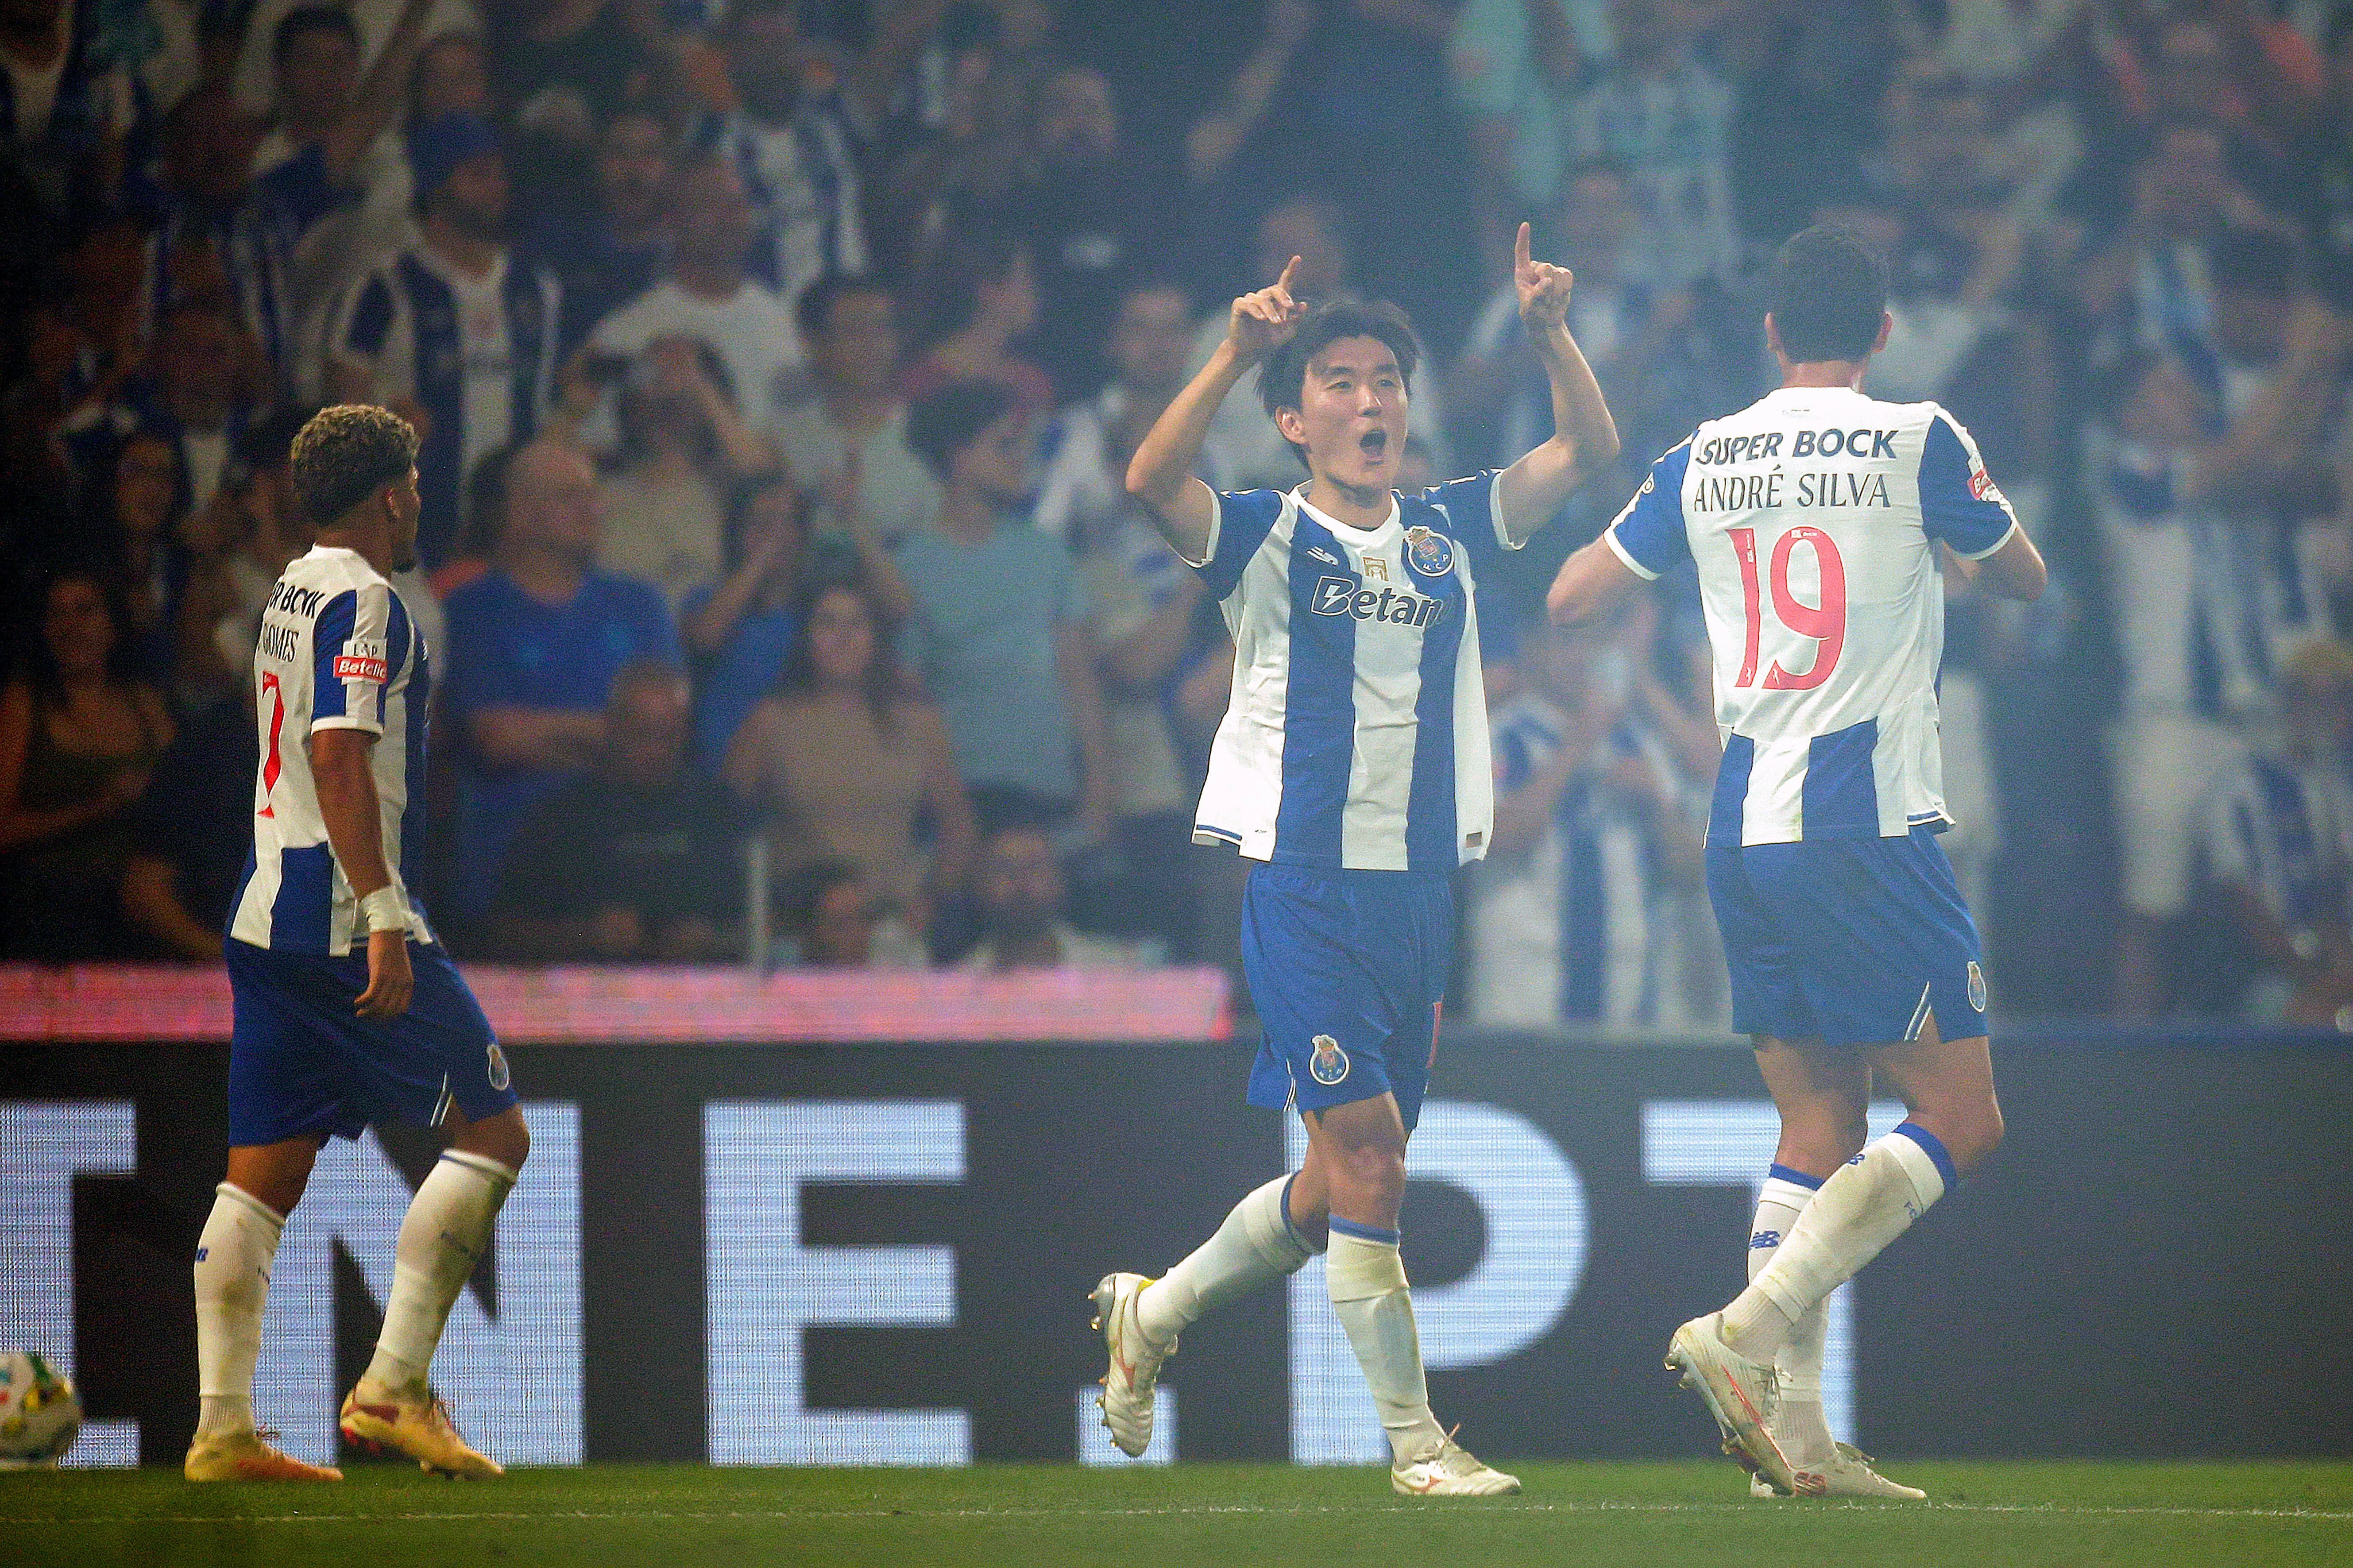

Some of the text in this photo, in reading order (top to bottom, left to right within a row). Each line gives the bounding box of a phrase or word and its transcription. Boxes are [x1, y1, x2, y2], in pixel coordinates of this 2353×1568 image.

[1695, 428, 1899, 465] SUPER BOCK
[1694, 463, 1891, 512] ANDRÉ SILVA
[1724, 526, 1846, 690] 19
